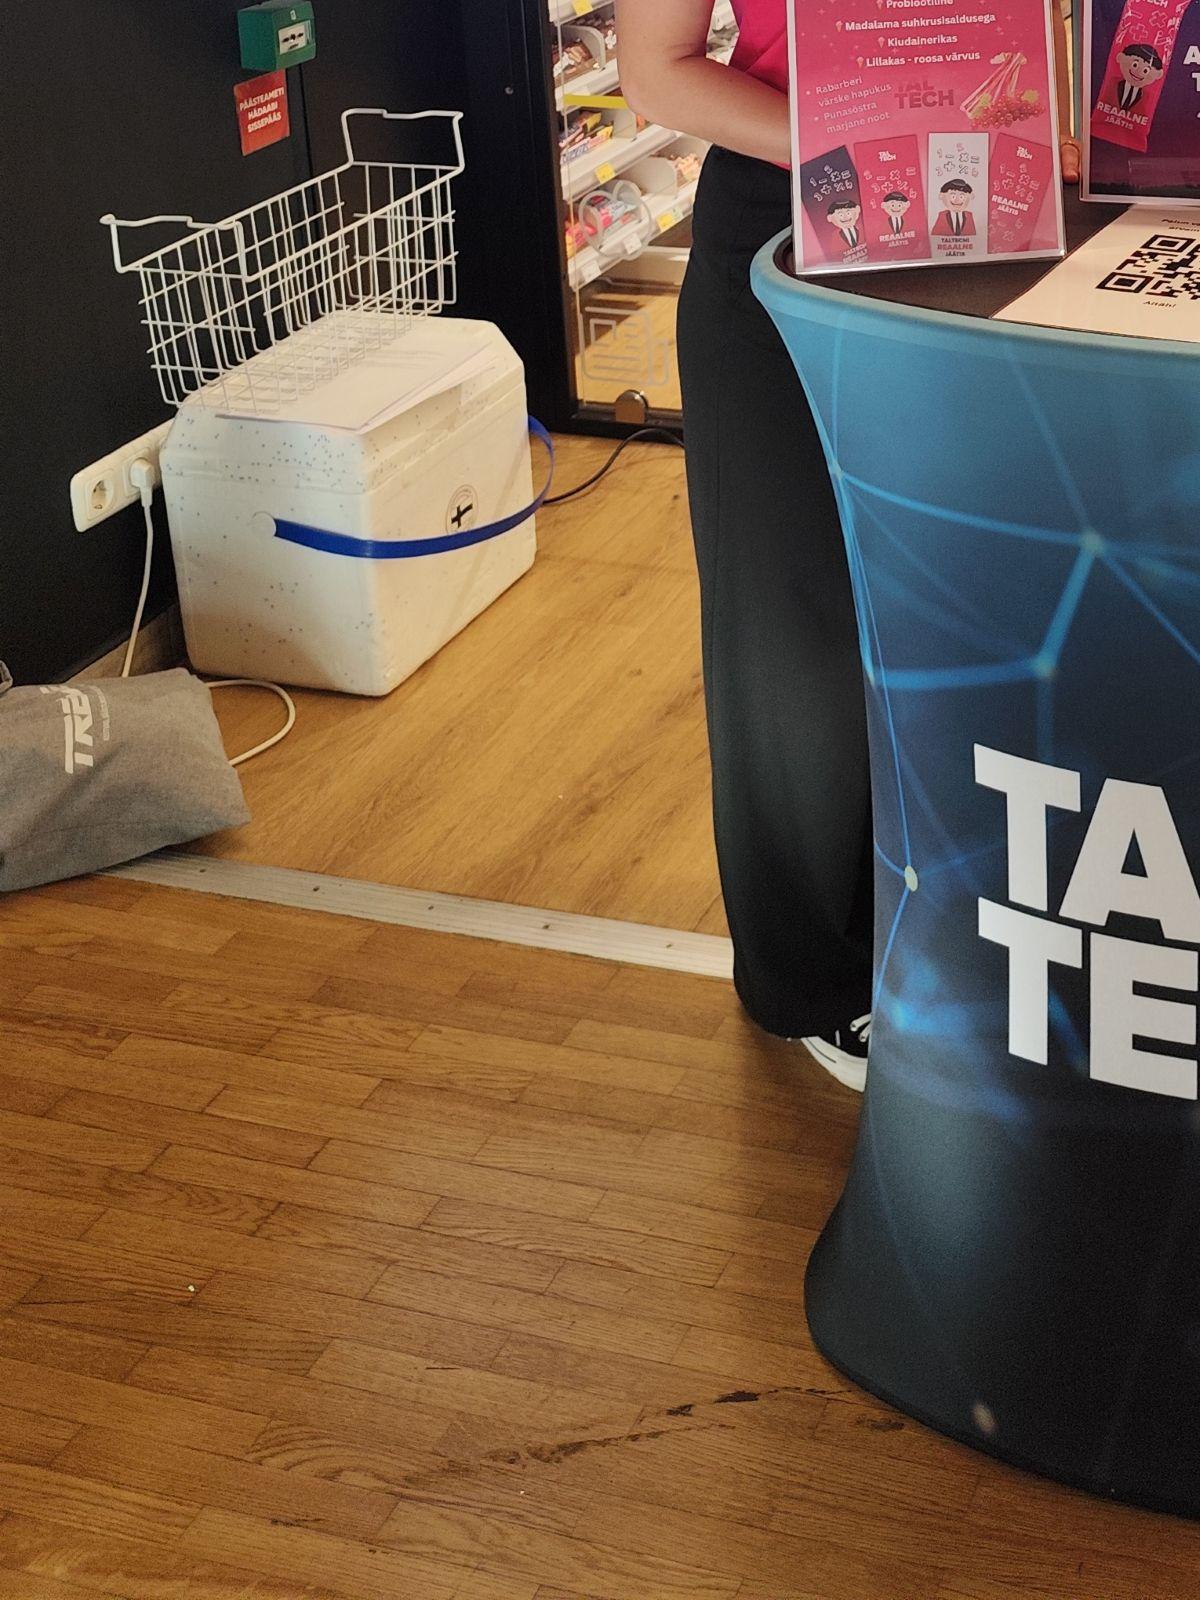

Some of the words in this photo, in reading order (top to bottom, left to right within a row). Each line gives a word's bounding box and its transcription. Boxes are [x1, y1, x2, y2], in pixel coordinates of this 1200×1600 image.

[845, 18, 900, 32] Madalama
[901, 11, 996, 29] suhkrusisaldusega
[887, 32, 958, 47] Kiudainerikas
[865, 54, 905, 67] Lillakas
[913, 54, 943, 64] roosa
[945, 49, 980, 62] värvus
[816, 76, 862, 94] Rabarberi
[851, 83, 892, 100] hapukus
[240, 87, 285, 111] PÄÄSTEAMETI
[895, 89, 954, 109] TECH
[868, 112, 890, 123] noot
[1097, 101, 1148, 126] REAALNE
[1105, 116, 1134, 131] JÄÄTIS
[992, 194, 1028, 211] REAALNE
[879, 231, 915, 242] REAALNE
